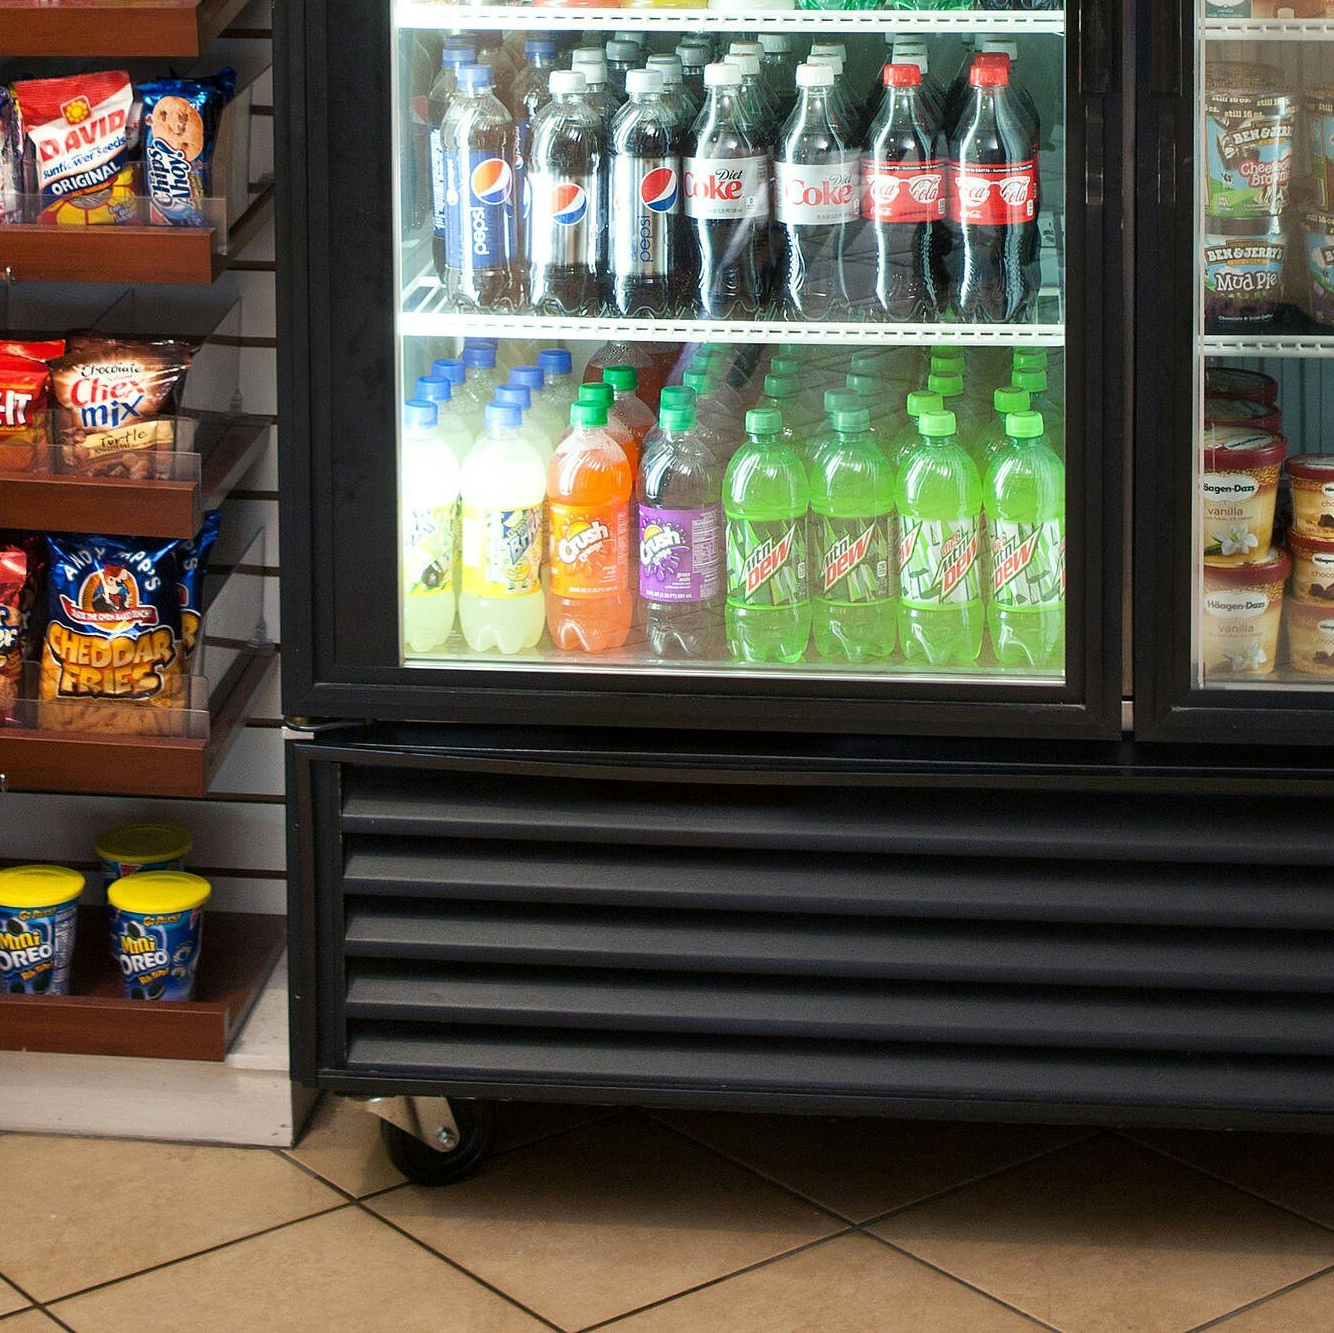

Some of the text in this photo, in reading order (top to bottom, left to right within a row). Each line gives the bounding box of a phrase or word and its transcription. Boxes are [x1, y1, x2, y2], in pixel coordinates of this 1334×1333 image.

[39, 108, 126, 162] DAVID
[50, 162, 121, 197] ORIGINAL
[684, 171, 743, 201] Coke
[715, 168, 743, 181] Diet
[785, 178, 853, 207] Coke
[470, 207, 490, 255] pepsi
[639, 215, 651, 263] pepsi
[1216, 272, 1278, 292] Mud Pie
[70, 377, 147, 407] Chex
[81, 394, 143, 429] mix
[100, 430, 147, 447] Turtle
[1207, 507, 1243, 516] vanilla
[558, 520, 609, 563] Crush
[48, 625, 175, 667] CHEDDAR
[61, 664, 160, 695] FRIES
[119, 950, 168, 975] OREO
